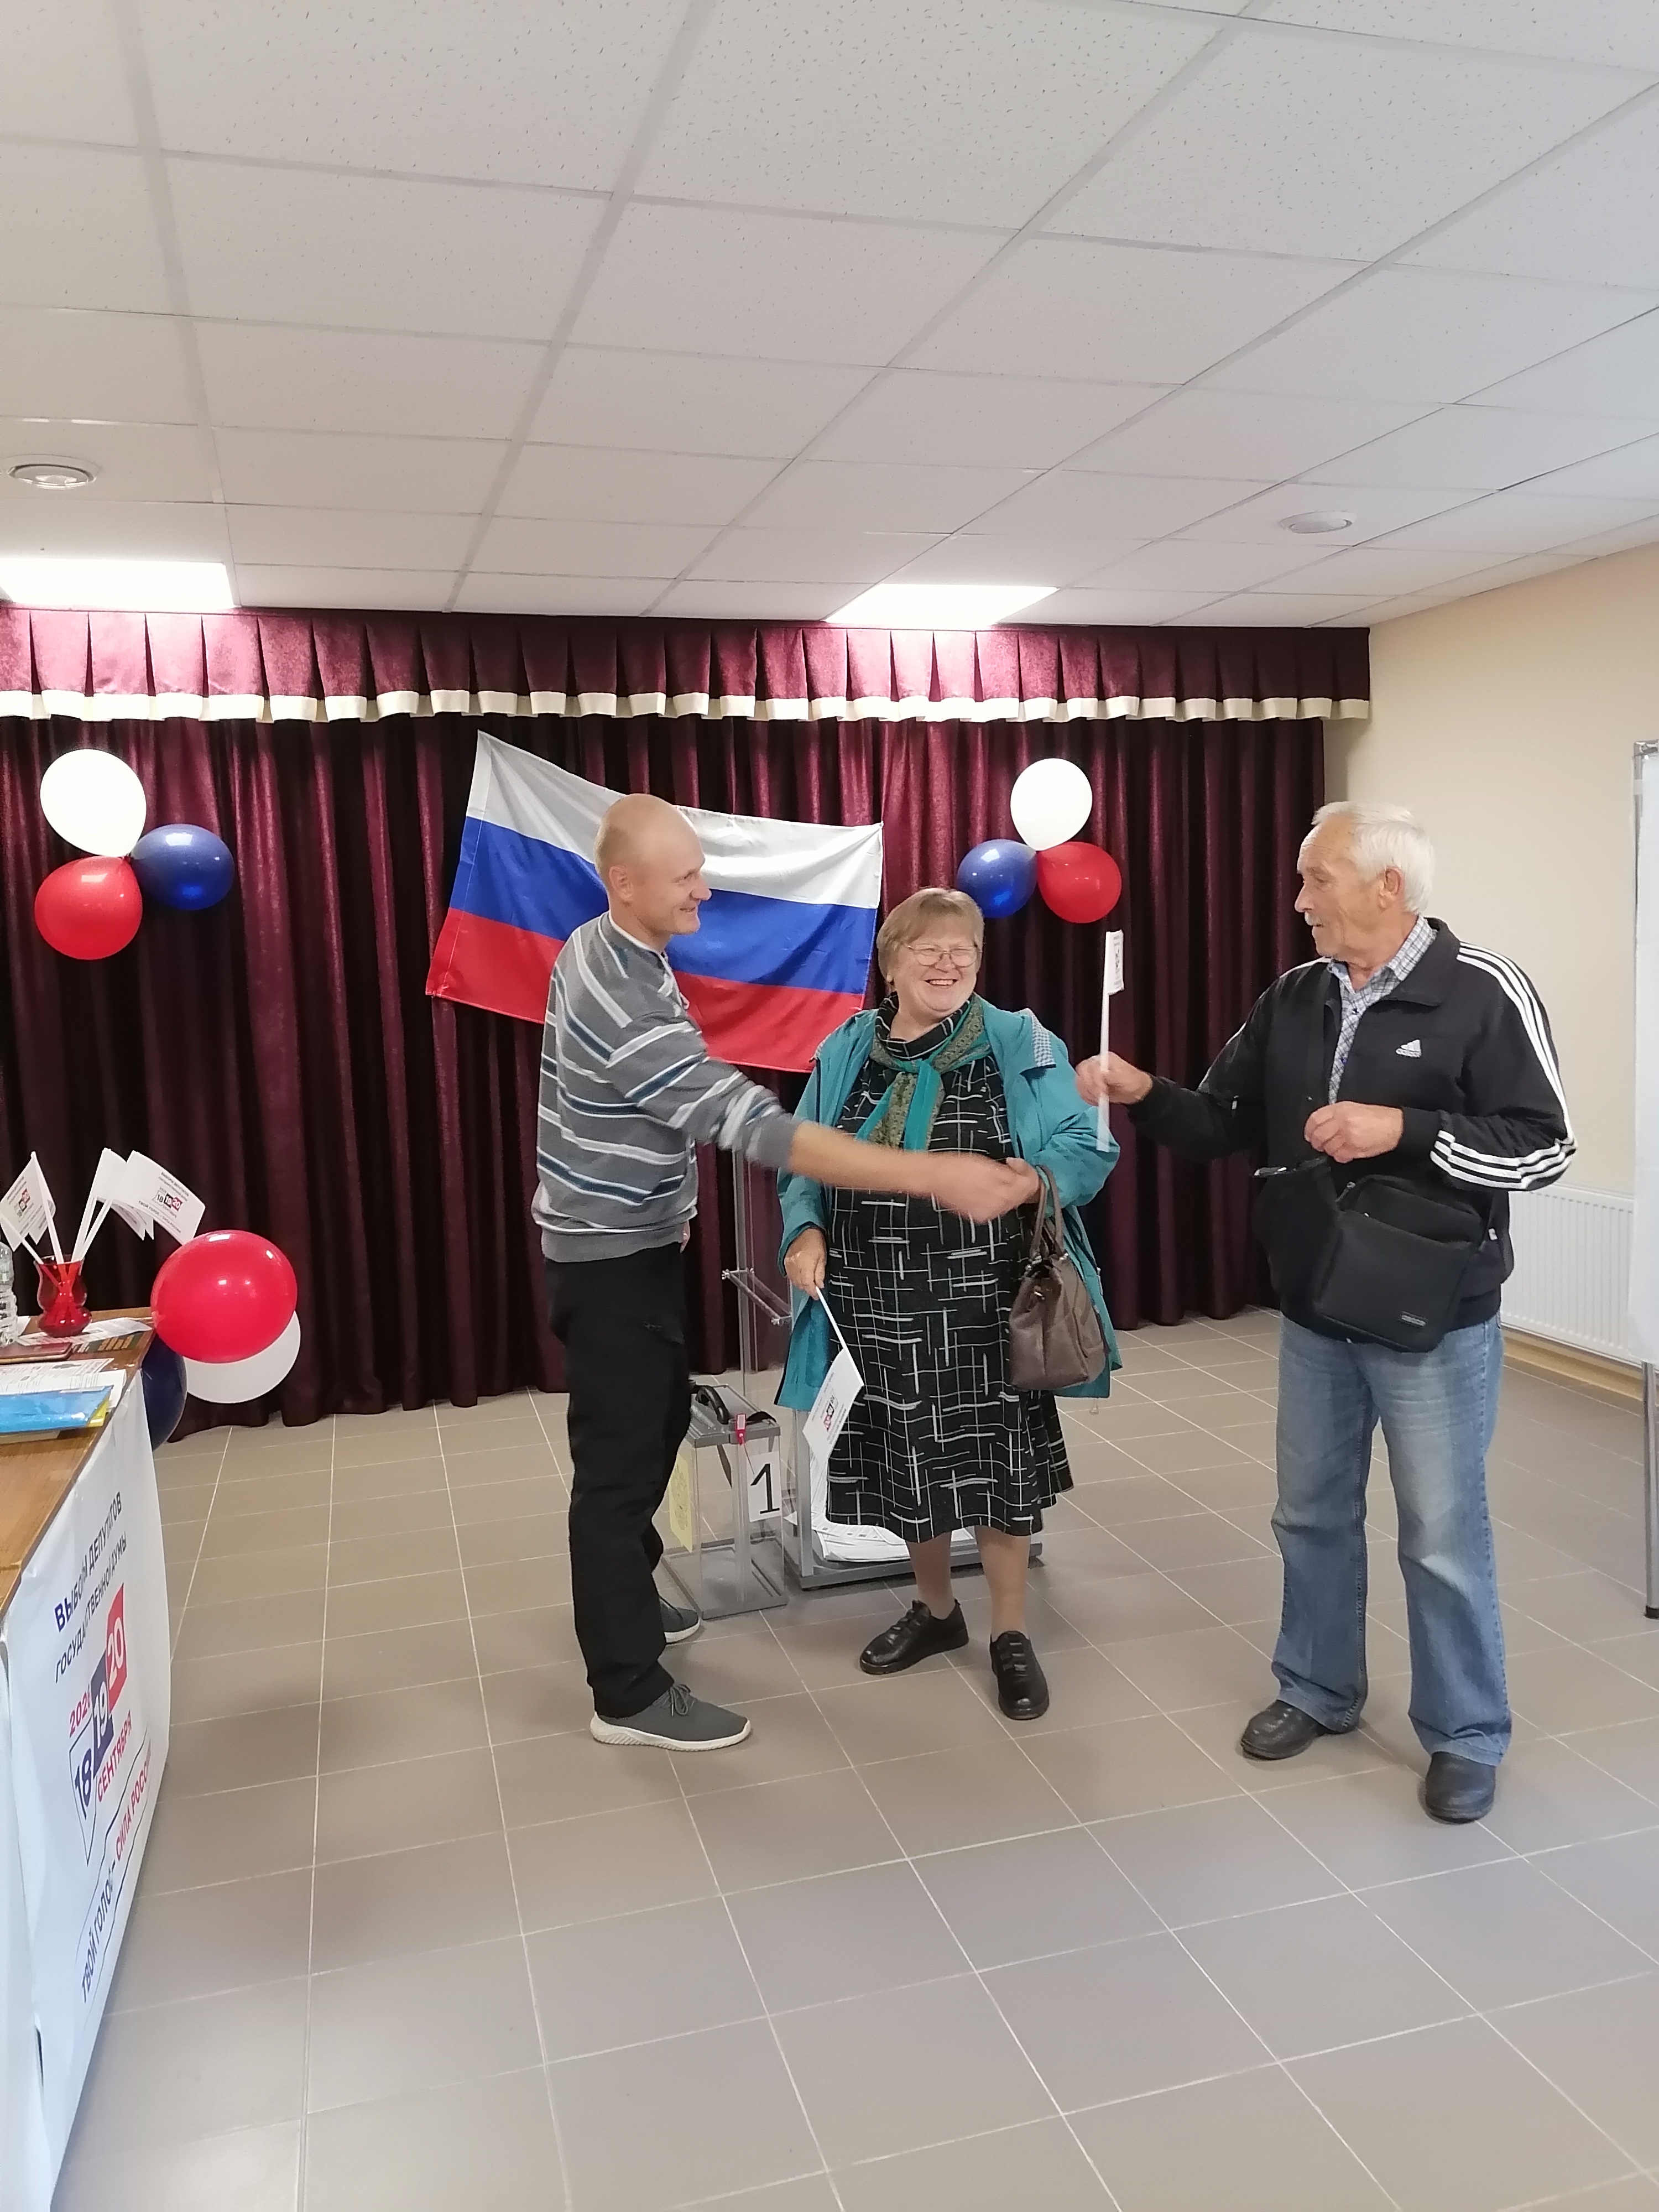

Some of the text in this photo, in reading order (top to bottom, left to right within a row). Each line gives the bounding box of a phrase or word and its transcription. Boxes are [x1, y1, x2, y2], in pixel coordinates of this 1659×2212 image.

[172, 1198, 181, 1208] 20
[750, 1463, 780, 1514] 1
[75, 1616, 124, 1820] 18 19 20
[97, 1710, 132, 1803] СЕНТЯБРЯ
[82, 1927, 97, 2004] ТВОЙ
[116, 1804, 132, 1861] СИЛА
